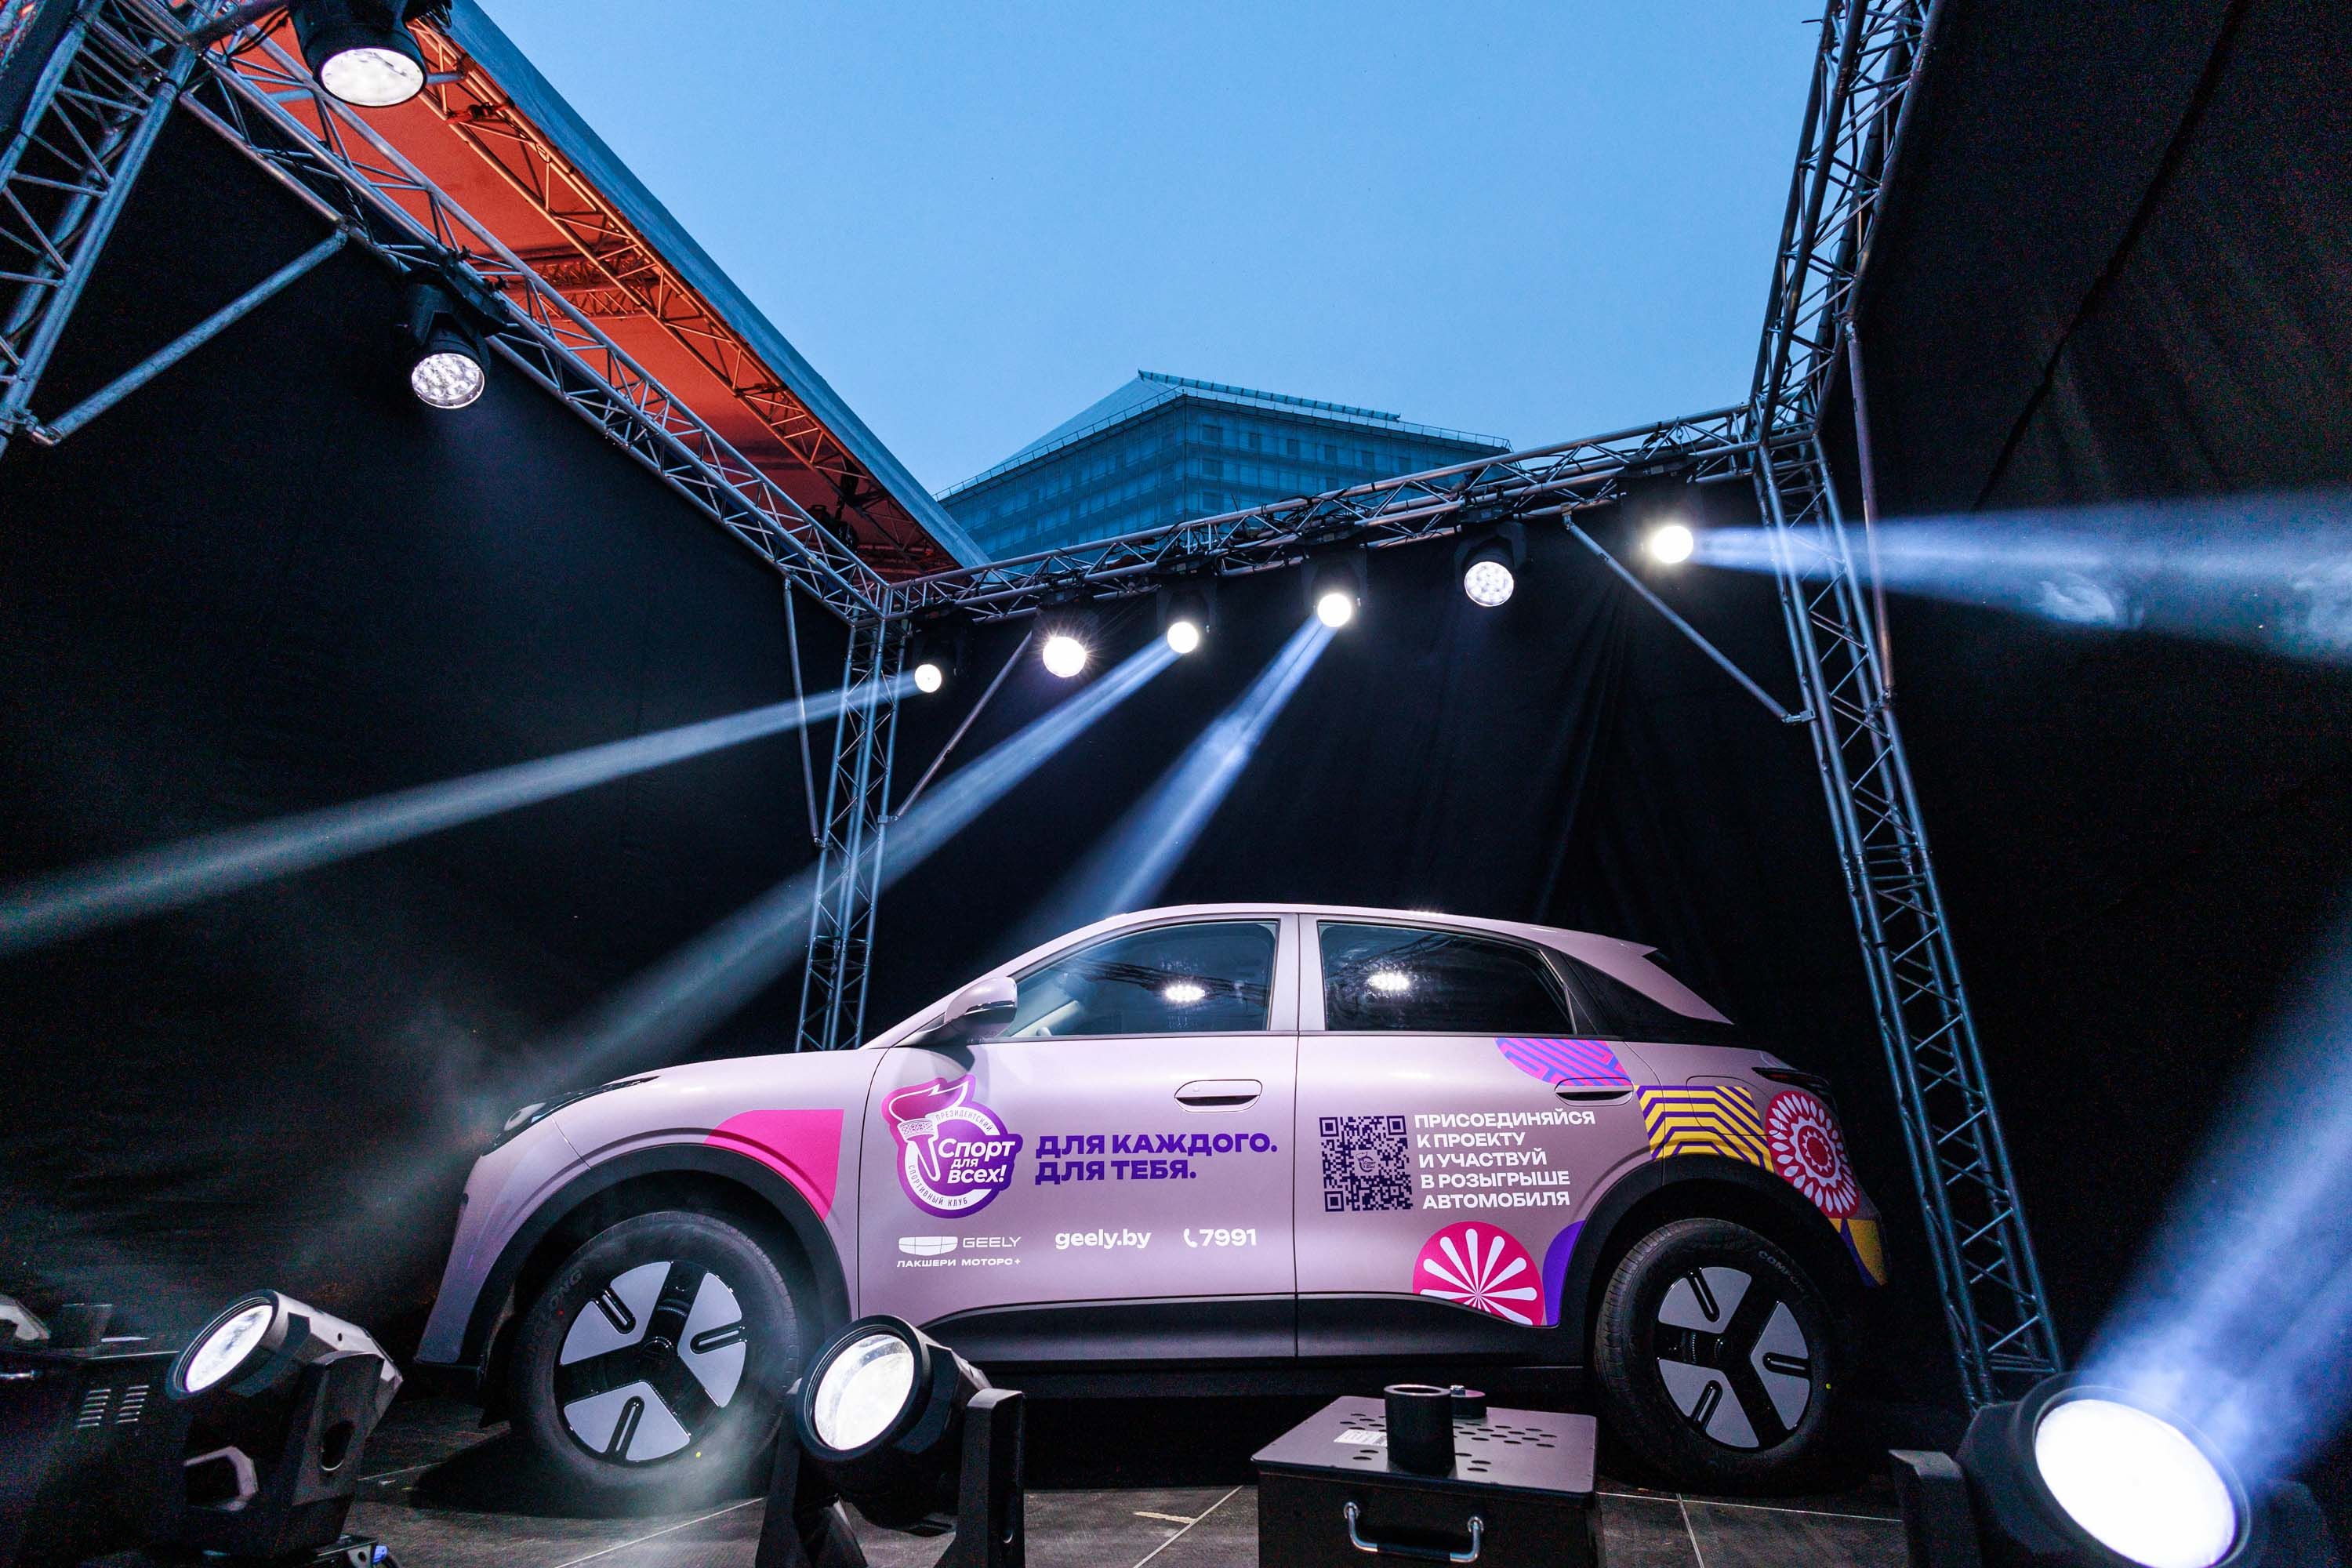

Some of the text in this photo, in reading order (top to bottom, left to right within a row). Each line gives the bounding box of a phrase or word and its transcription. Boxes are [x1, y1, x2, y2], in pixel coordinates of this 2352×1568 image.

[935, 1109, 993, 1131] ПРЕЗИДЕНТСКИЙ
[1414, 1109, 1595, 1129] ПРИСОЕДИНЯЙСЯ
[1035, 1133, 1277, 1159] ДЛЯ КАЖДОГО.
[1417, 1131, 1525, 1148] К ПРОЕКТУ
[938, 1138, 1015, 1162] Спорт
[1418, 1148, 1547, 1168] И УЧАСТВУЙ
[950, 1158, 978, 1169] для
[1035, 1160, 1197, 1185] ДЛЯ ТЕБЯ.
[947, 1164, 1007, 1184] всех!
[1421, 1171, 1570, 1189] В РОЗЫГРЫШЕ
[908, 1165, 968, 1207] СПОРТИВНЫЙ КЛУБ
[1423, 1191, 1570, 1210] АВТОМОБИЛЯ
[962, 1236, 1022, 1248] GEELY
[1055, 1229, 1151, 1250] geely.by
[1200, 1229, 1258, 1247] 7991
[897, 1259, 956, 1268] ЛАКШЕРИ
